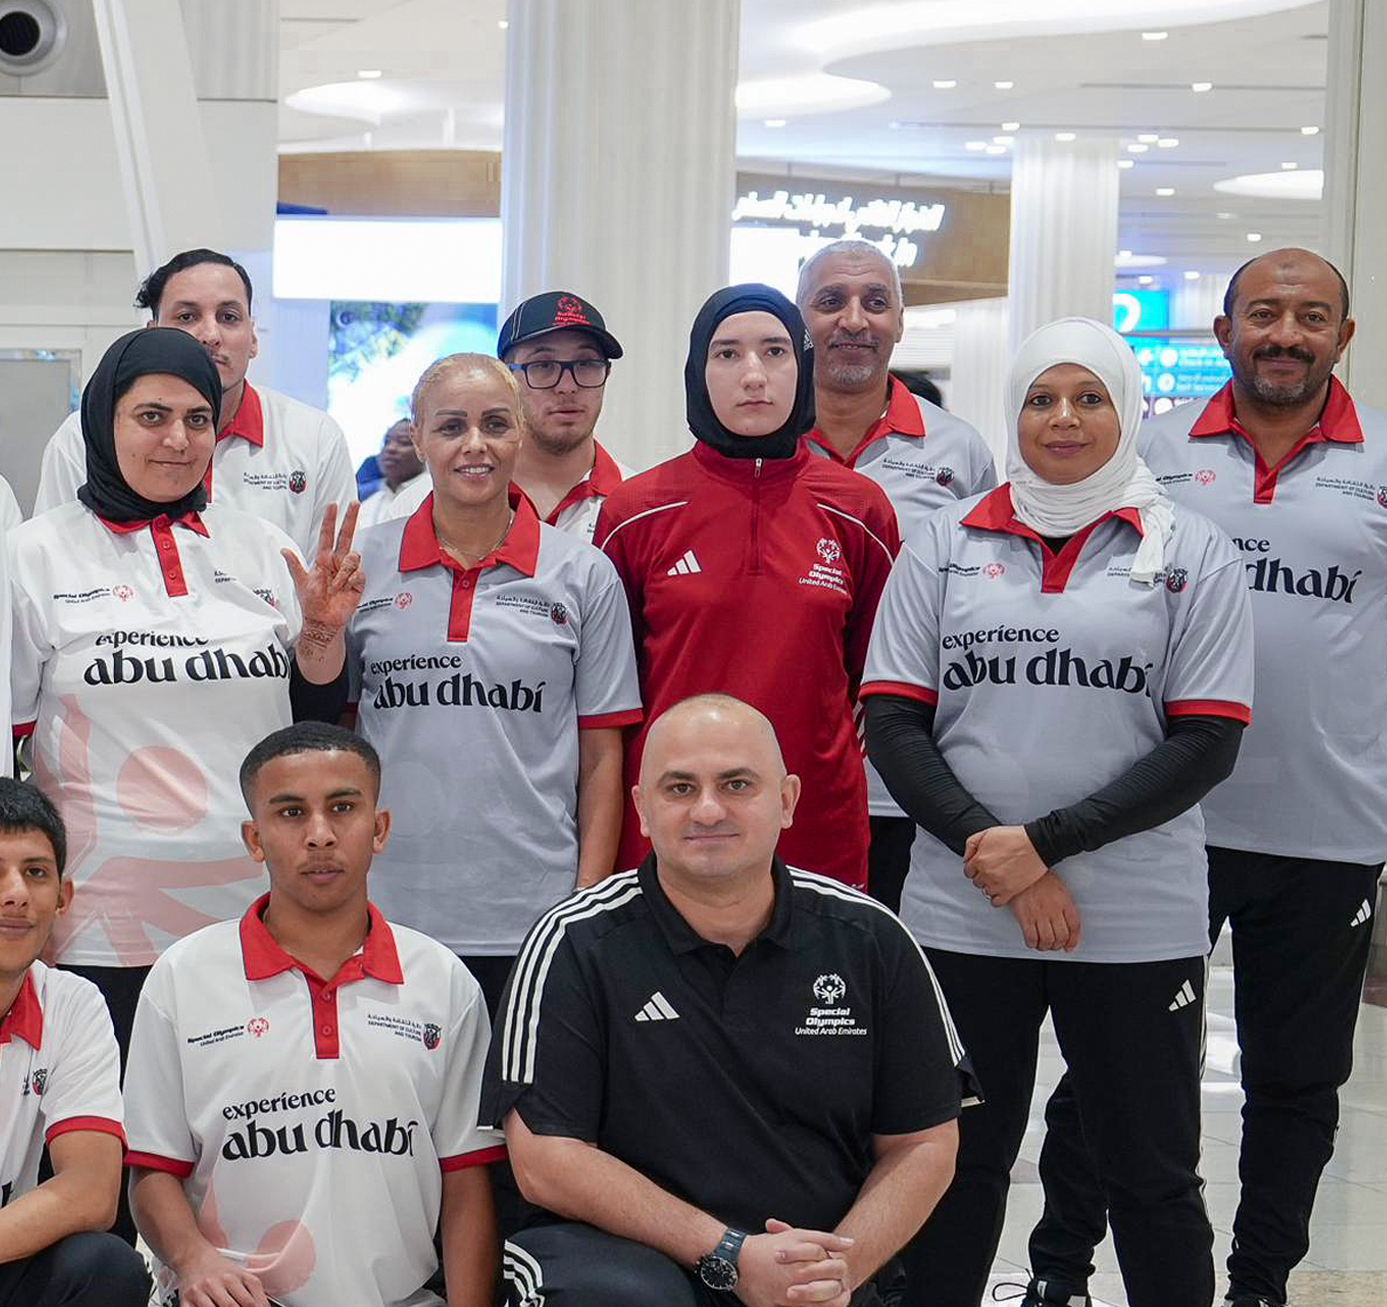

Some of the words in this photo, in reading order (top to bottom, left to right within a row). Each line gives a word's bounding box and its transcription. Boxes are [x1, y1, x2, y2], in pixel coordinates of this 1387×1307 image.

[813, 563, 843, 575] Special
[942, 625, 1060, 650] experience
[84, 649, 177, 686] abu
[185, 644, 290, 680] dhab
[371, 655, 461, 676] experience
[943, 650, 1016, 690] abu
[374, 677, 430, 710] abu
[437, 674, 546, 713] dhabi
[806, 1018, 855, 1027] Olympics
[810, 1008, 850, 1017] Special
[795, 1027, 818, 1035] United
[222, 1088, 335, 1120] experience
[222, 1120, 308, 1161] abu
[315, 1109, 419, 1157] dhabi
